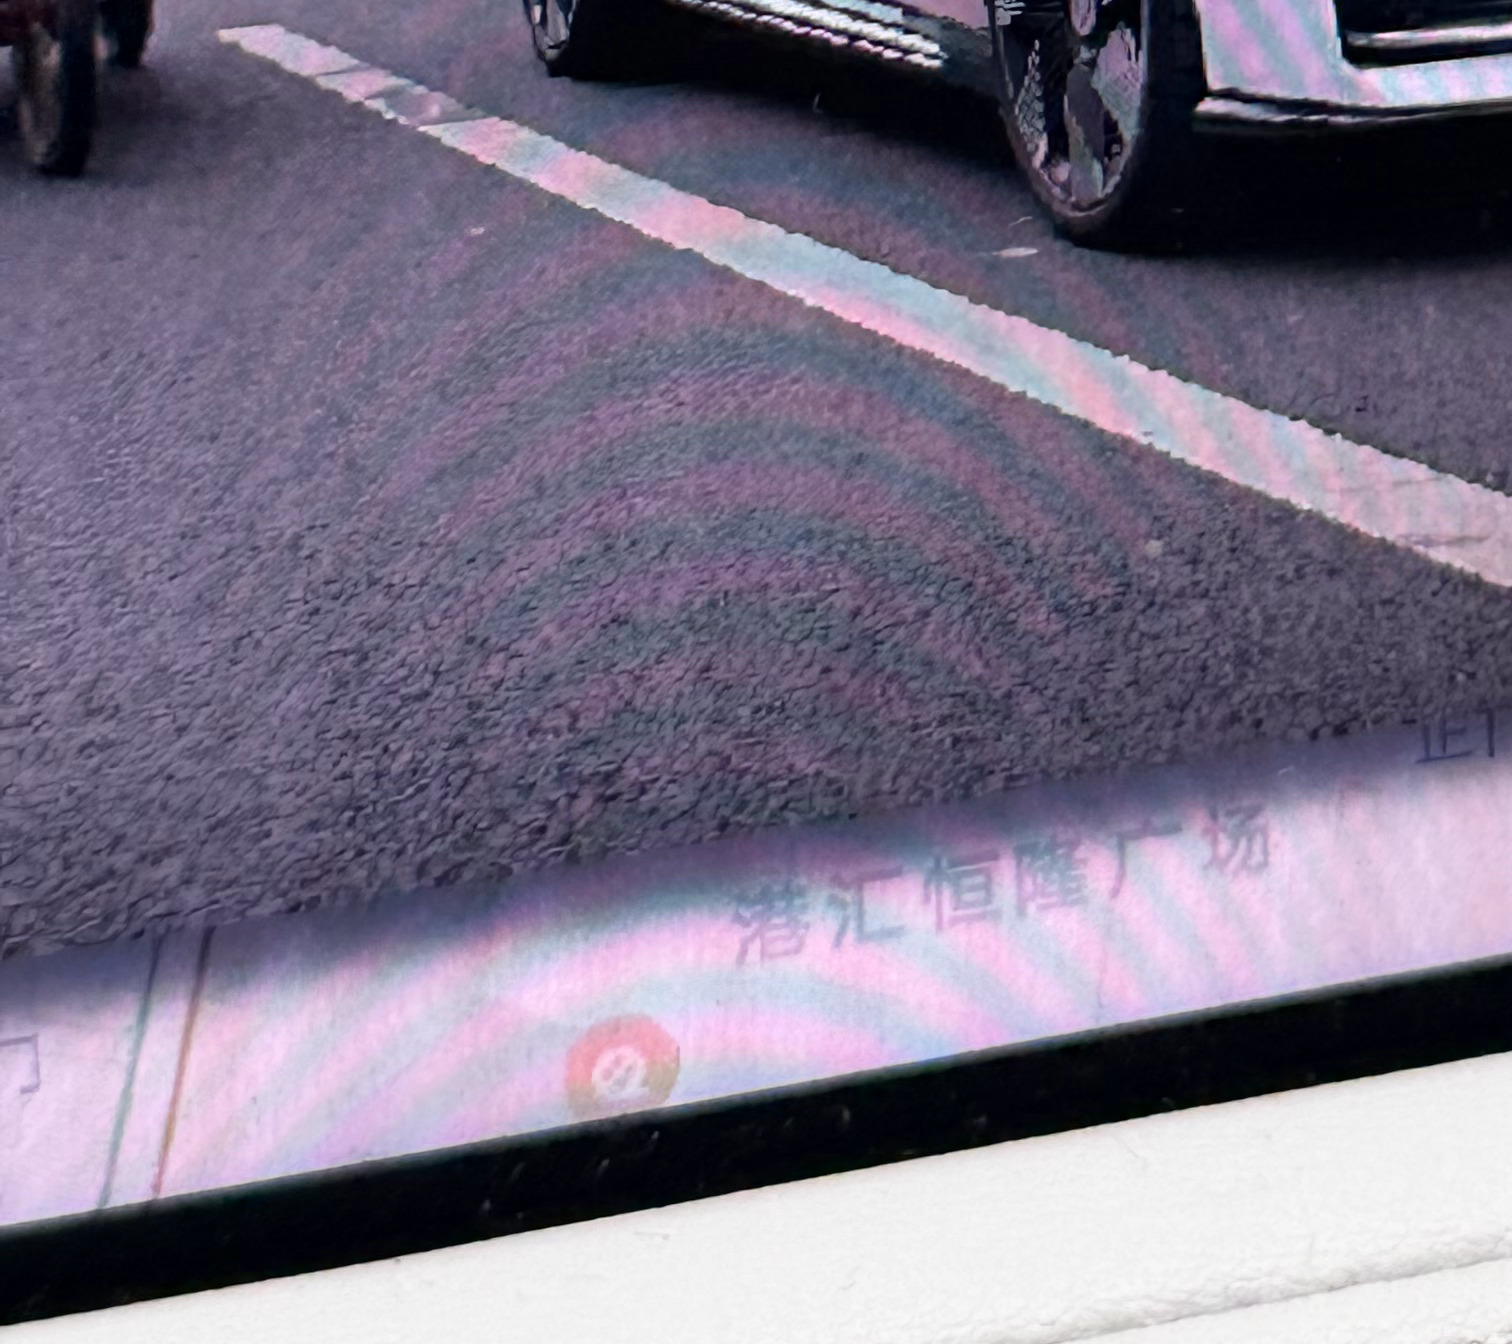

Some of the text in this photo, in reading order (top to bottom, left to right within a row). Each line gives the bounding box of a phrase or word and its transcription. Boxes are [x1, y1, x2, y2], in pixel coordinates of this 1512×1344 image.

[728, 802, 1272, 965] 港汇恒隆广场
